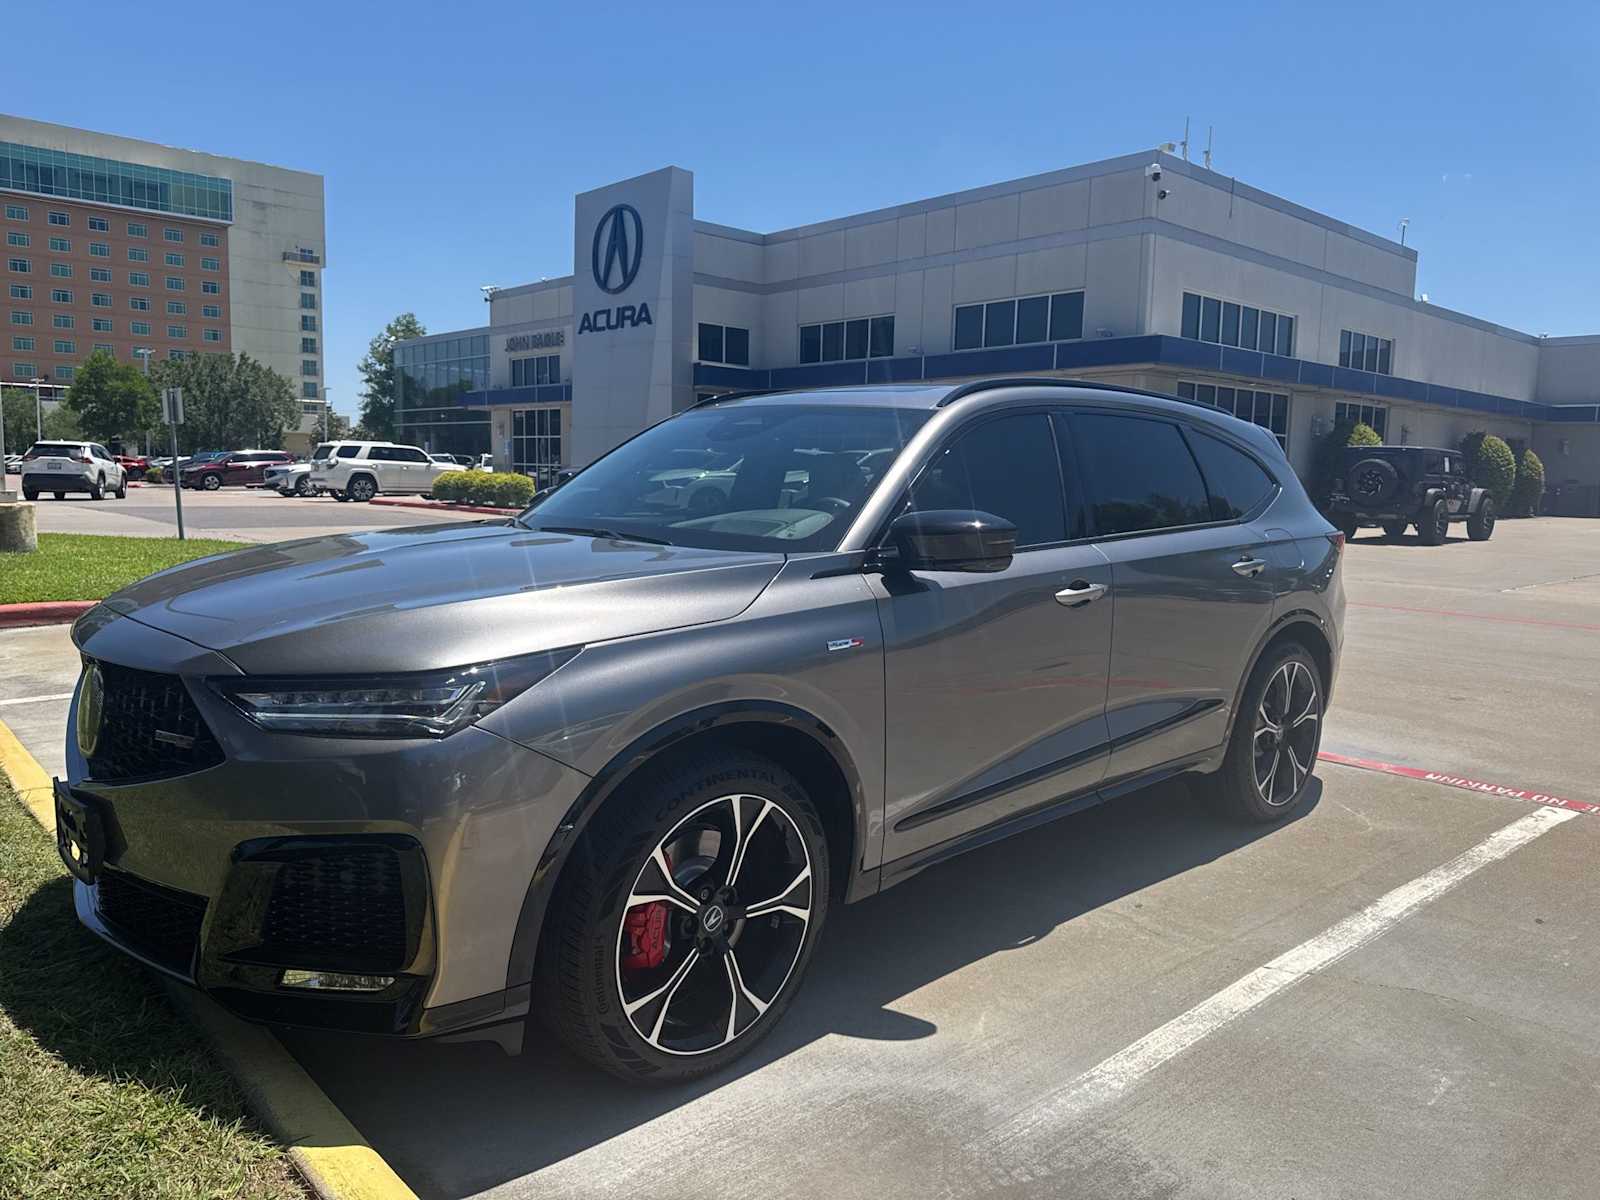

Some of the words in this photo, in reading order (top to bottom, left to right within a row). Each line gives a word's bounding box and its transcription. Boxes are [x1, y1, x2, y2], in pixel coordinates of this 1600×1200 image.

[578, 302, 653, 335] ACURA
[656, 768, 780, 823] CONTINENTAL
[1532, 794, 1569, 806] NO
